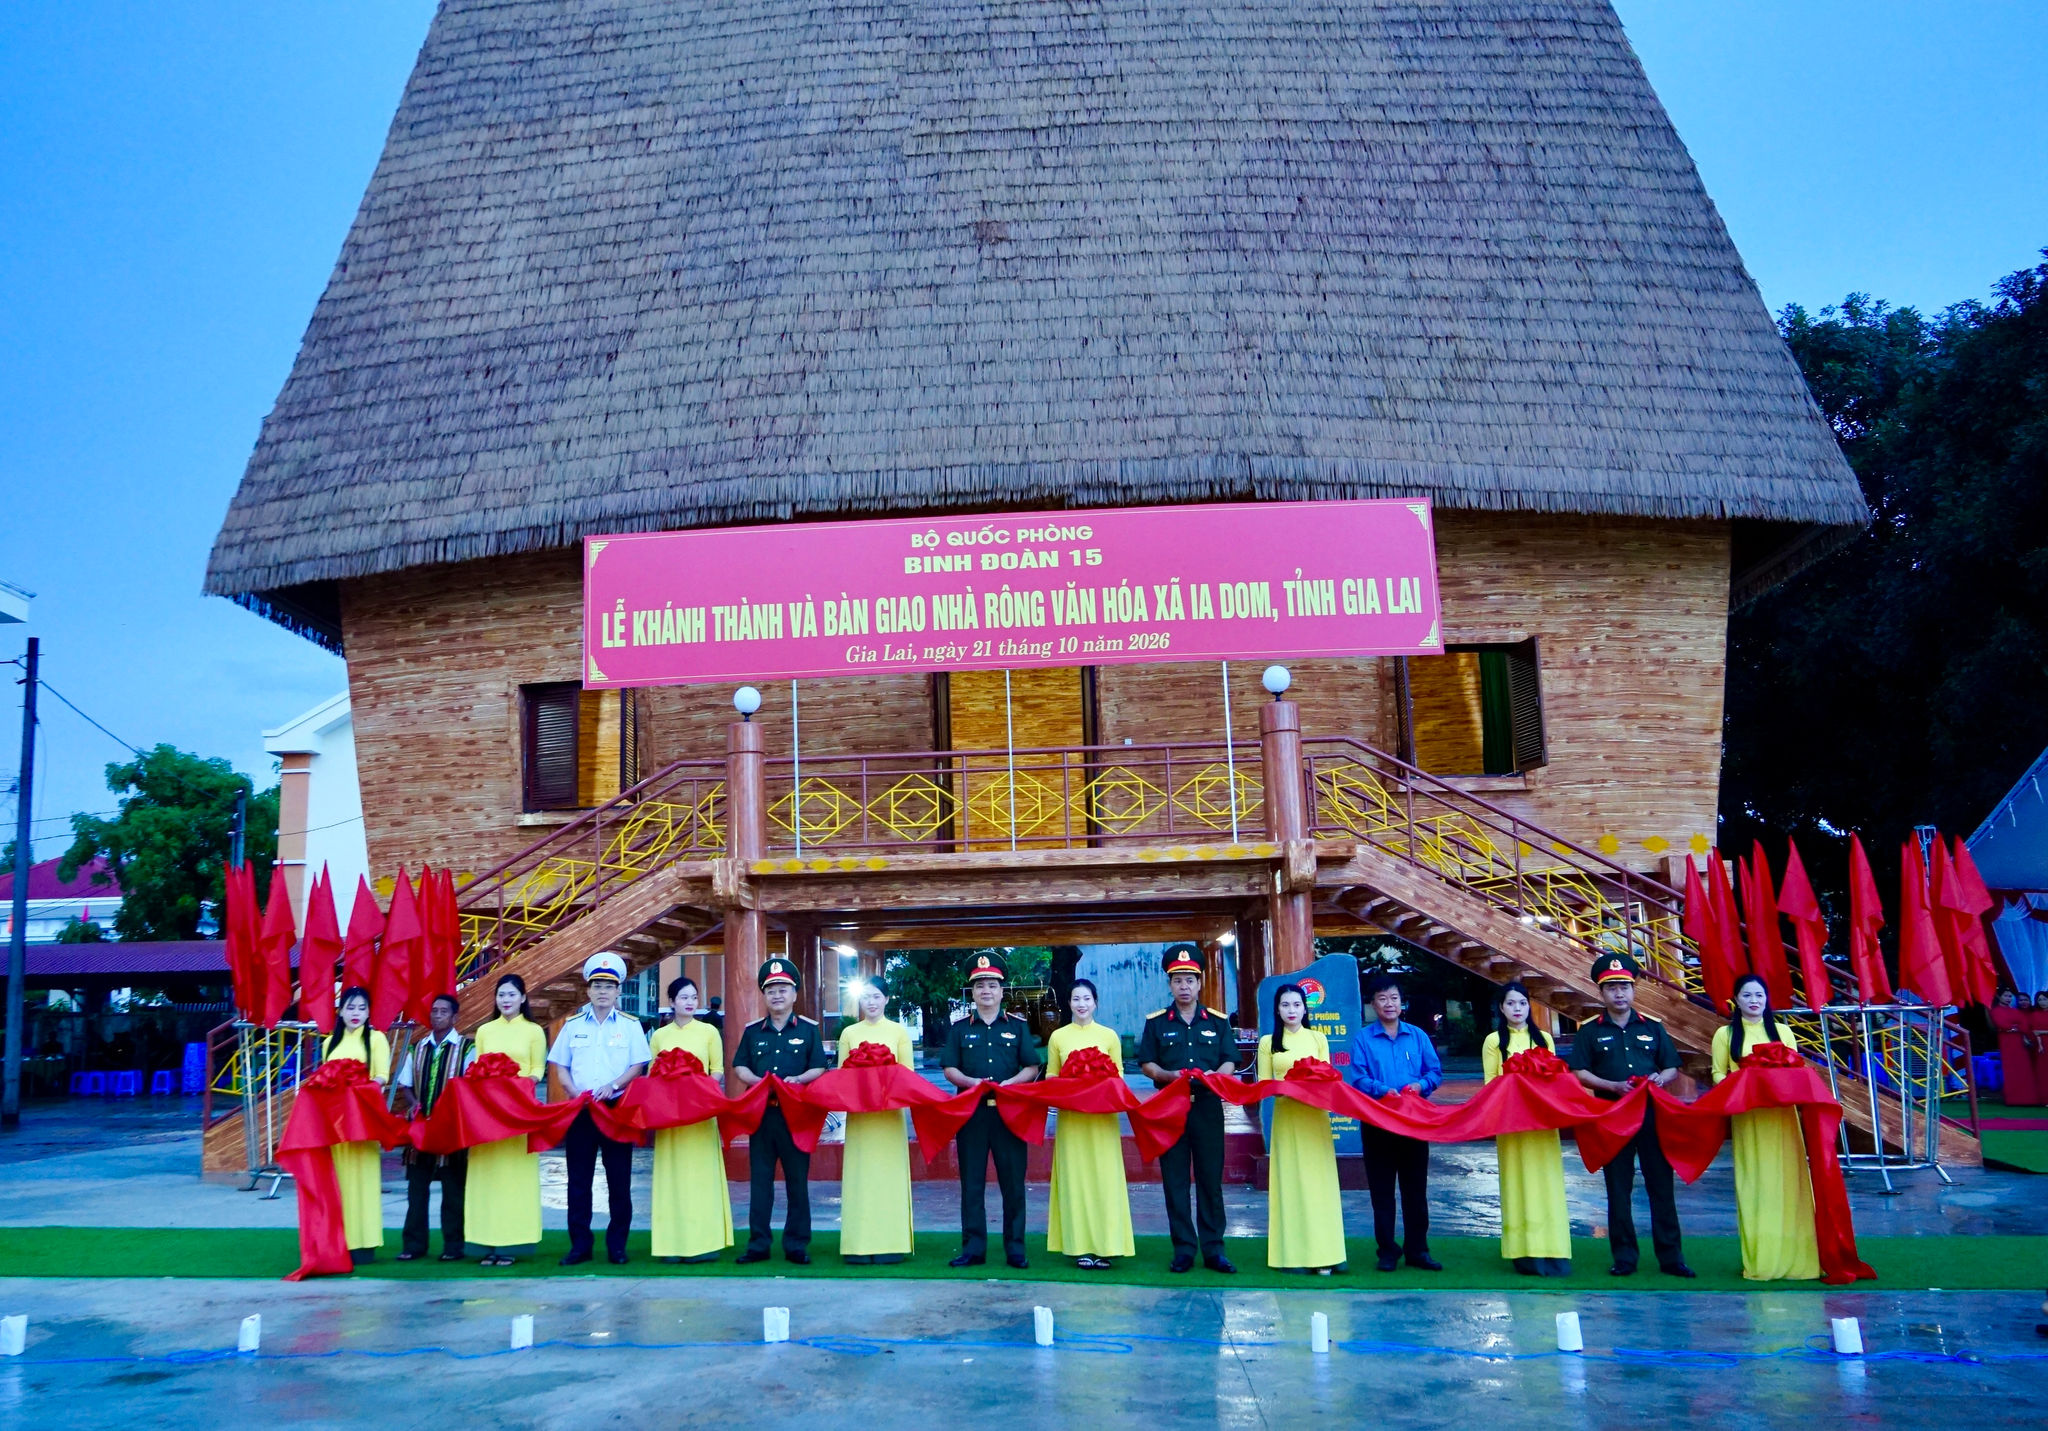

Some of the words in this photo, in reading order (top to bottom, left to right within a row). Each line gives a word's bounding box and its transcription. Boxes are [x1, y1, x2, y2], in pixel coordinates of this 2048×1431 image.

[911, 529, 941, 551] BỘ
[946, 524, 1011, 547] QUỐC
[1016, 523, 1094, 544] PHÒNG
[903, 554, 972, 575] BINH
[979, 548, 1060, 571] ĐOÀN
[1068, 549, 1103, 567] 15
[601, 598, 627, 649] LỄ
[632, 600, 706, 647] KHÁNH
[711, 596, 784, 642] THÀNH
[788, 593, 818, 639] VÀ
[823, 591, 869, 637] BÀN
[875, 595, 926, 635] GIAO
[932, 585, 980, 631] NHÀ
[983, 583, 1046, 629] RÔNG
[1050, 580, 1097, 626] VĂN
[1101, 578, 1149, 624] HÓA
[1152, 576, 1186, 622] XÃ
[1189, 583, 1215, 621] IA
[1218, 581, 1279, 623] DOM,
[1282, 567, 1337, 617] TỈNH
[1341, 577, 1383, 616] GIA
[1385, 576, 1423, 615] LAI
[845, 645, 878, 664] Gia
[882, 643, 918, 664] Lai,
[922, 640, 969, 663] ngày
[971, 640, 992, 657] 21
[998, 638, 1054, 659] tháng
[1057, 636, 1079, 654] 10
[1082, 635, 1124, 653] năm
[1127, 632, 1171, 651] 2026
[1334, 1024, 1347, 1035] 15
